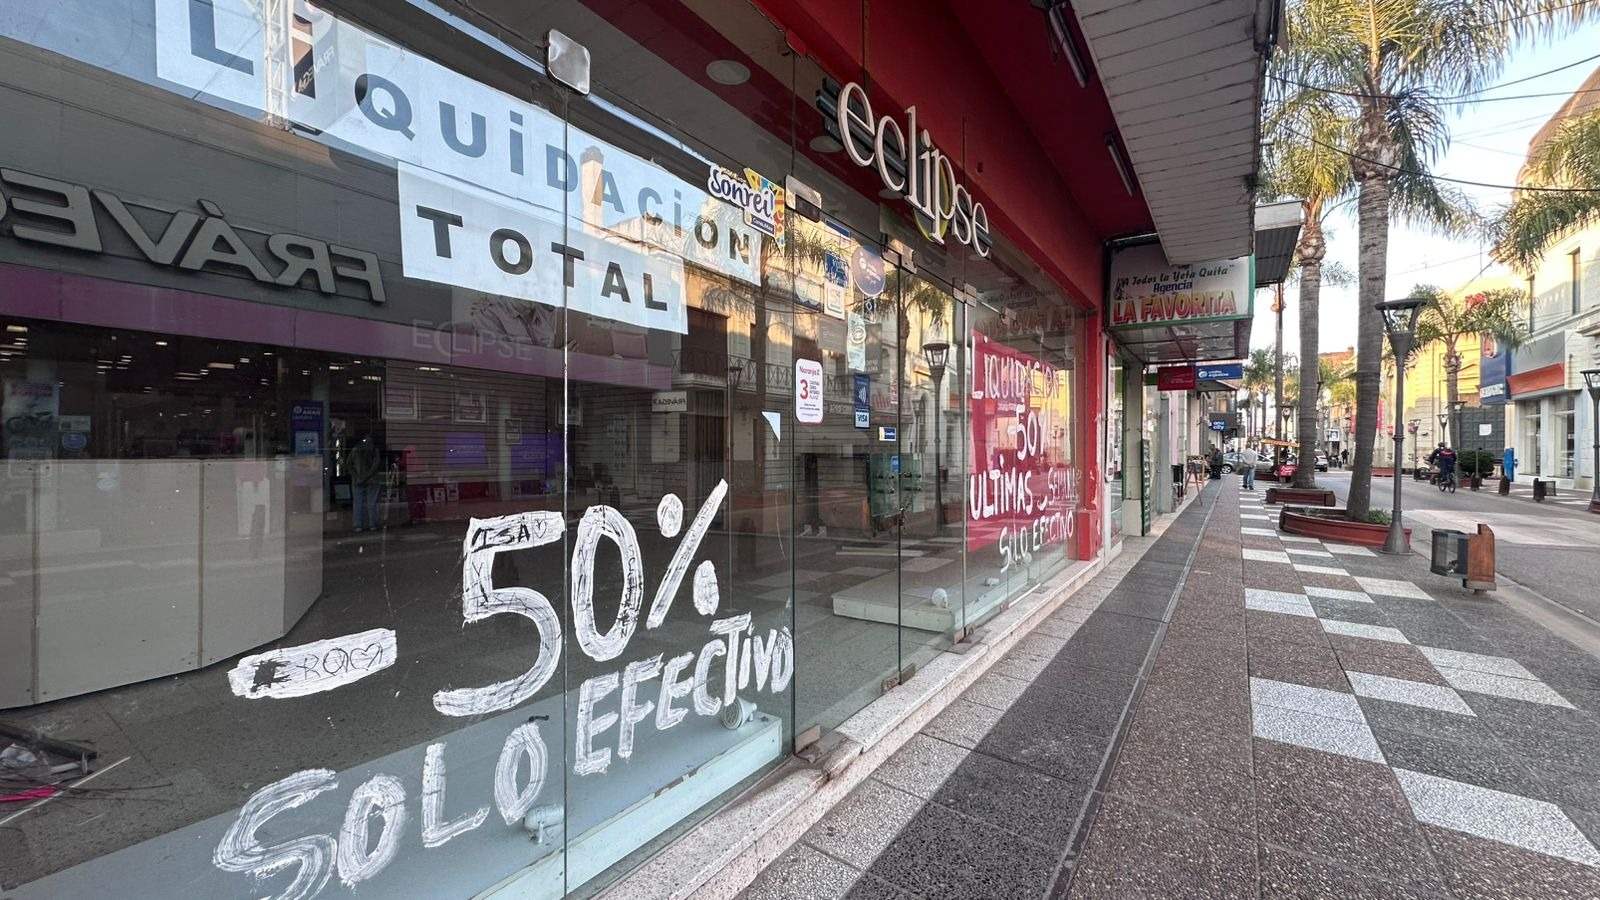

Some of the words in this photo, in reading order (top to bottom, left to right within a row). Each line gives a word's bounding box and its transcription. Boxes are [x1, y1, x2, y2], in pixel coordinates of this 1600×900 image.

[837, 81, 991, 258] eclipse
[416, 205, 668, 312] TOTAL
[1153, 280, 1193, 295] Agencia
[1160, 272, 1170, 282] la
[1112, 299, 1137, 324] LA
[1140, 289, 1237, 321] FAVORITA
[800, 378, 809, 400] 3
[856, 414, 868, 422] VISA
[212, 718, 549, 900] SOLO
